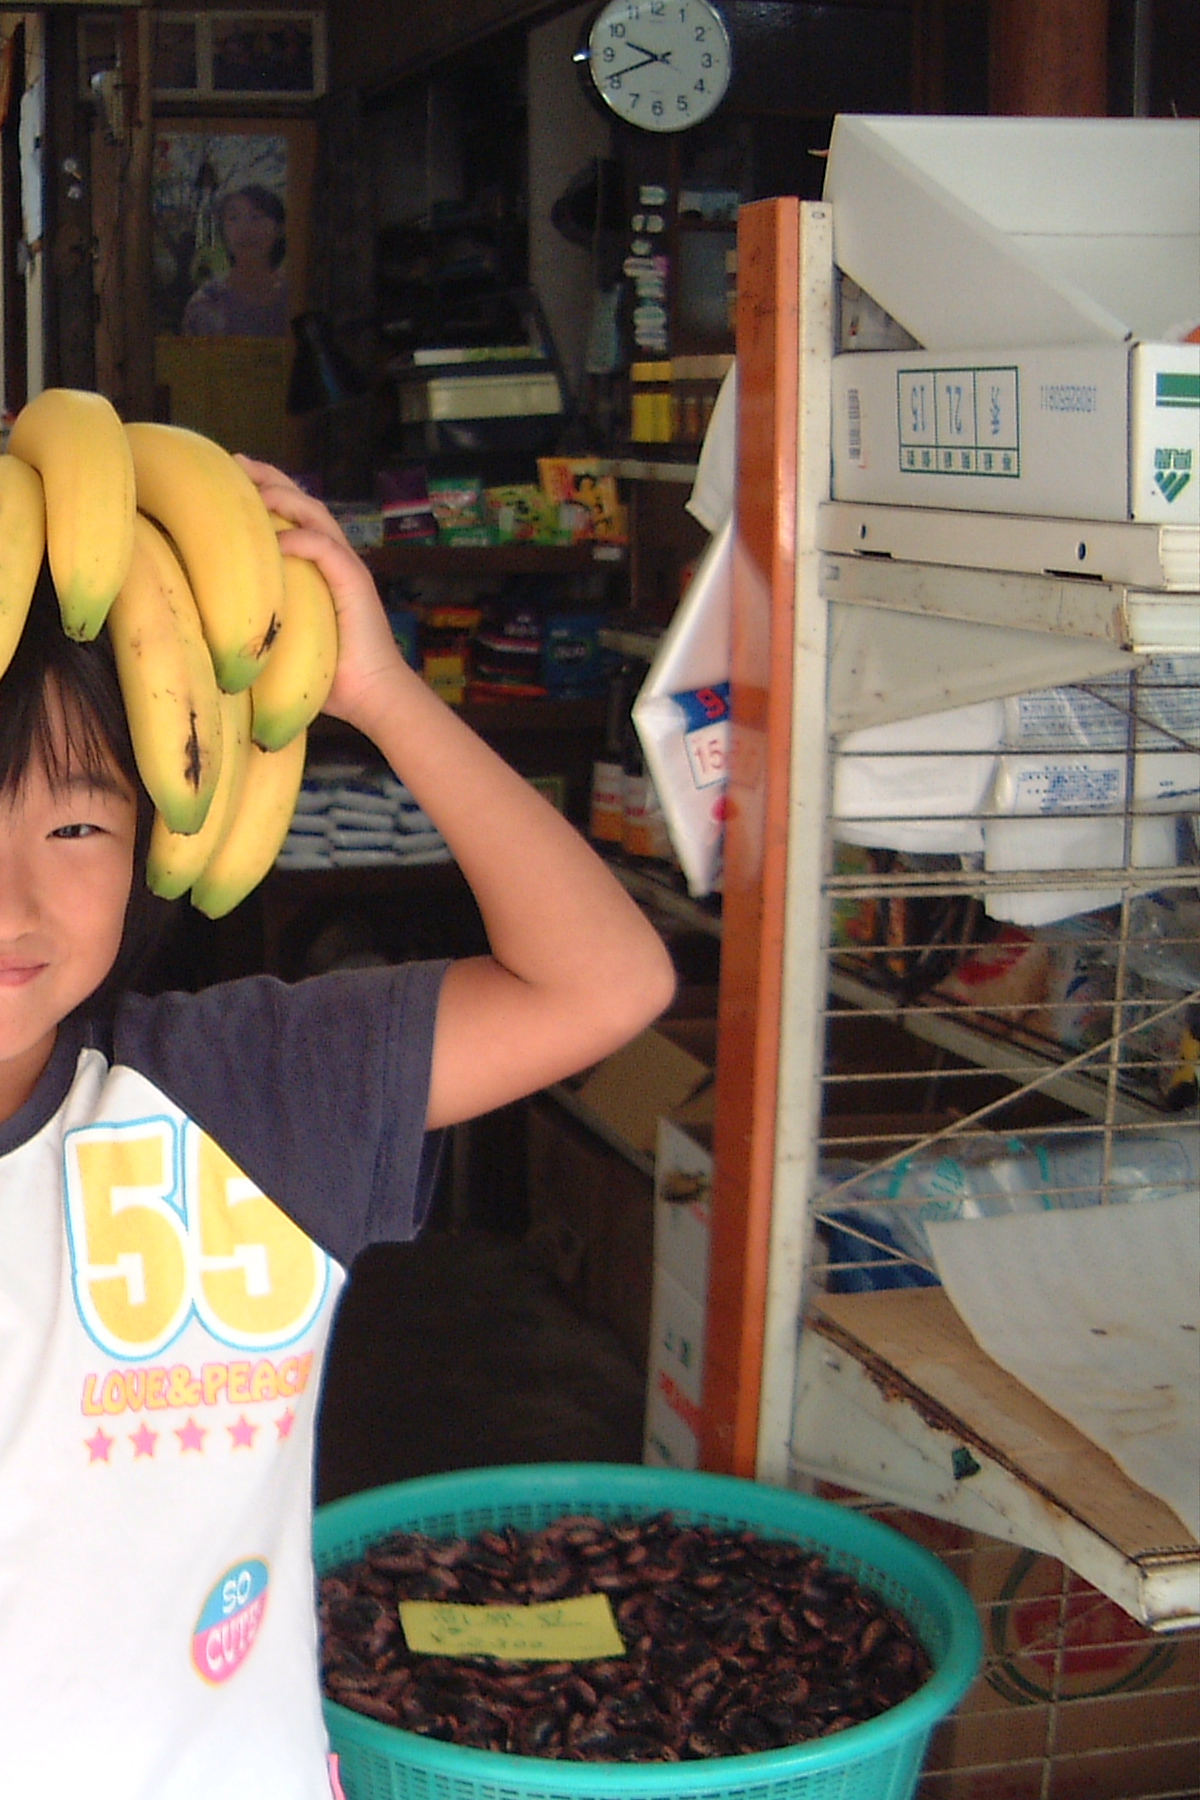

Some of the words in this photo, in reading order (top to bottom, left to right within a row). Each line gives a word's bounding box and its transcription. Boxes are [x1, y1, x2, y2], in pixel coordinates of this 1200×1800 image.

[651, 0, 665, 16] 12
[609, 23, 626, 38] 10
[695, 27, 705, 42] 2
[603, 47, 615, 62] 9
[701, 53, 712, 68] 3
[694, 79, 705, 92] 4
[629, 93, 640, 109] 7
[652, 101, 664, 116] 6
[677, 96, 688, 111] 5
[67, 1117, 329, 1357] 55
[221, 1568, 252, 1615] SO
